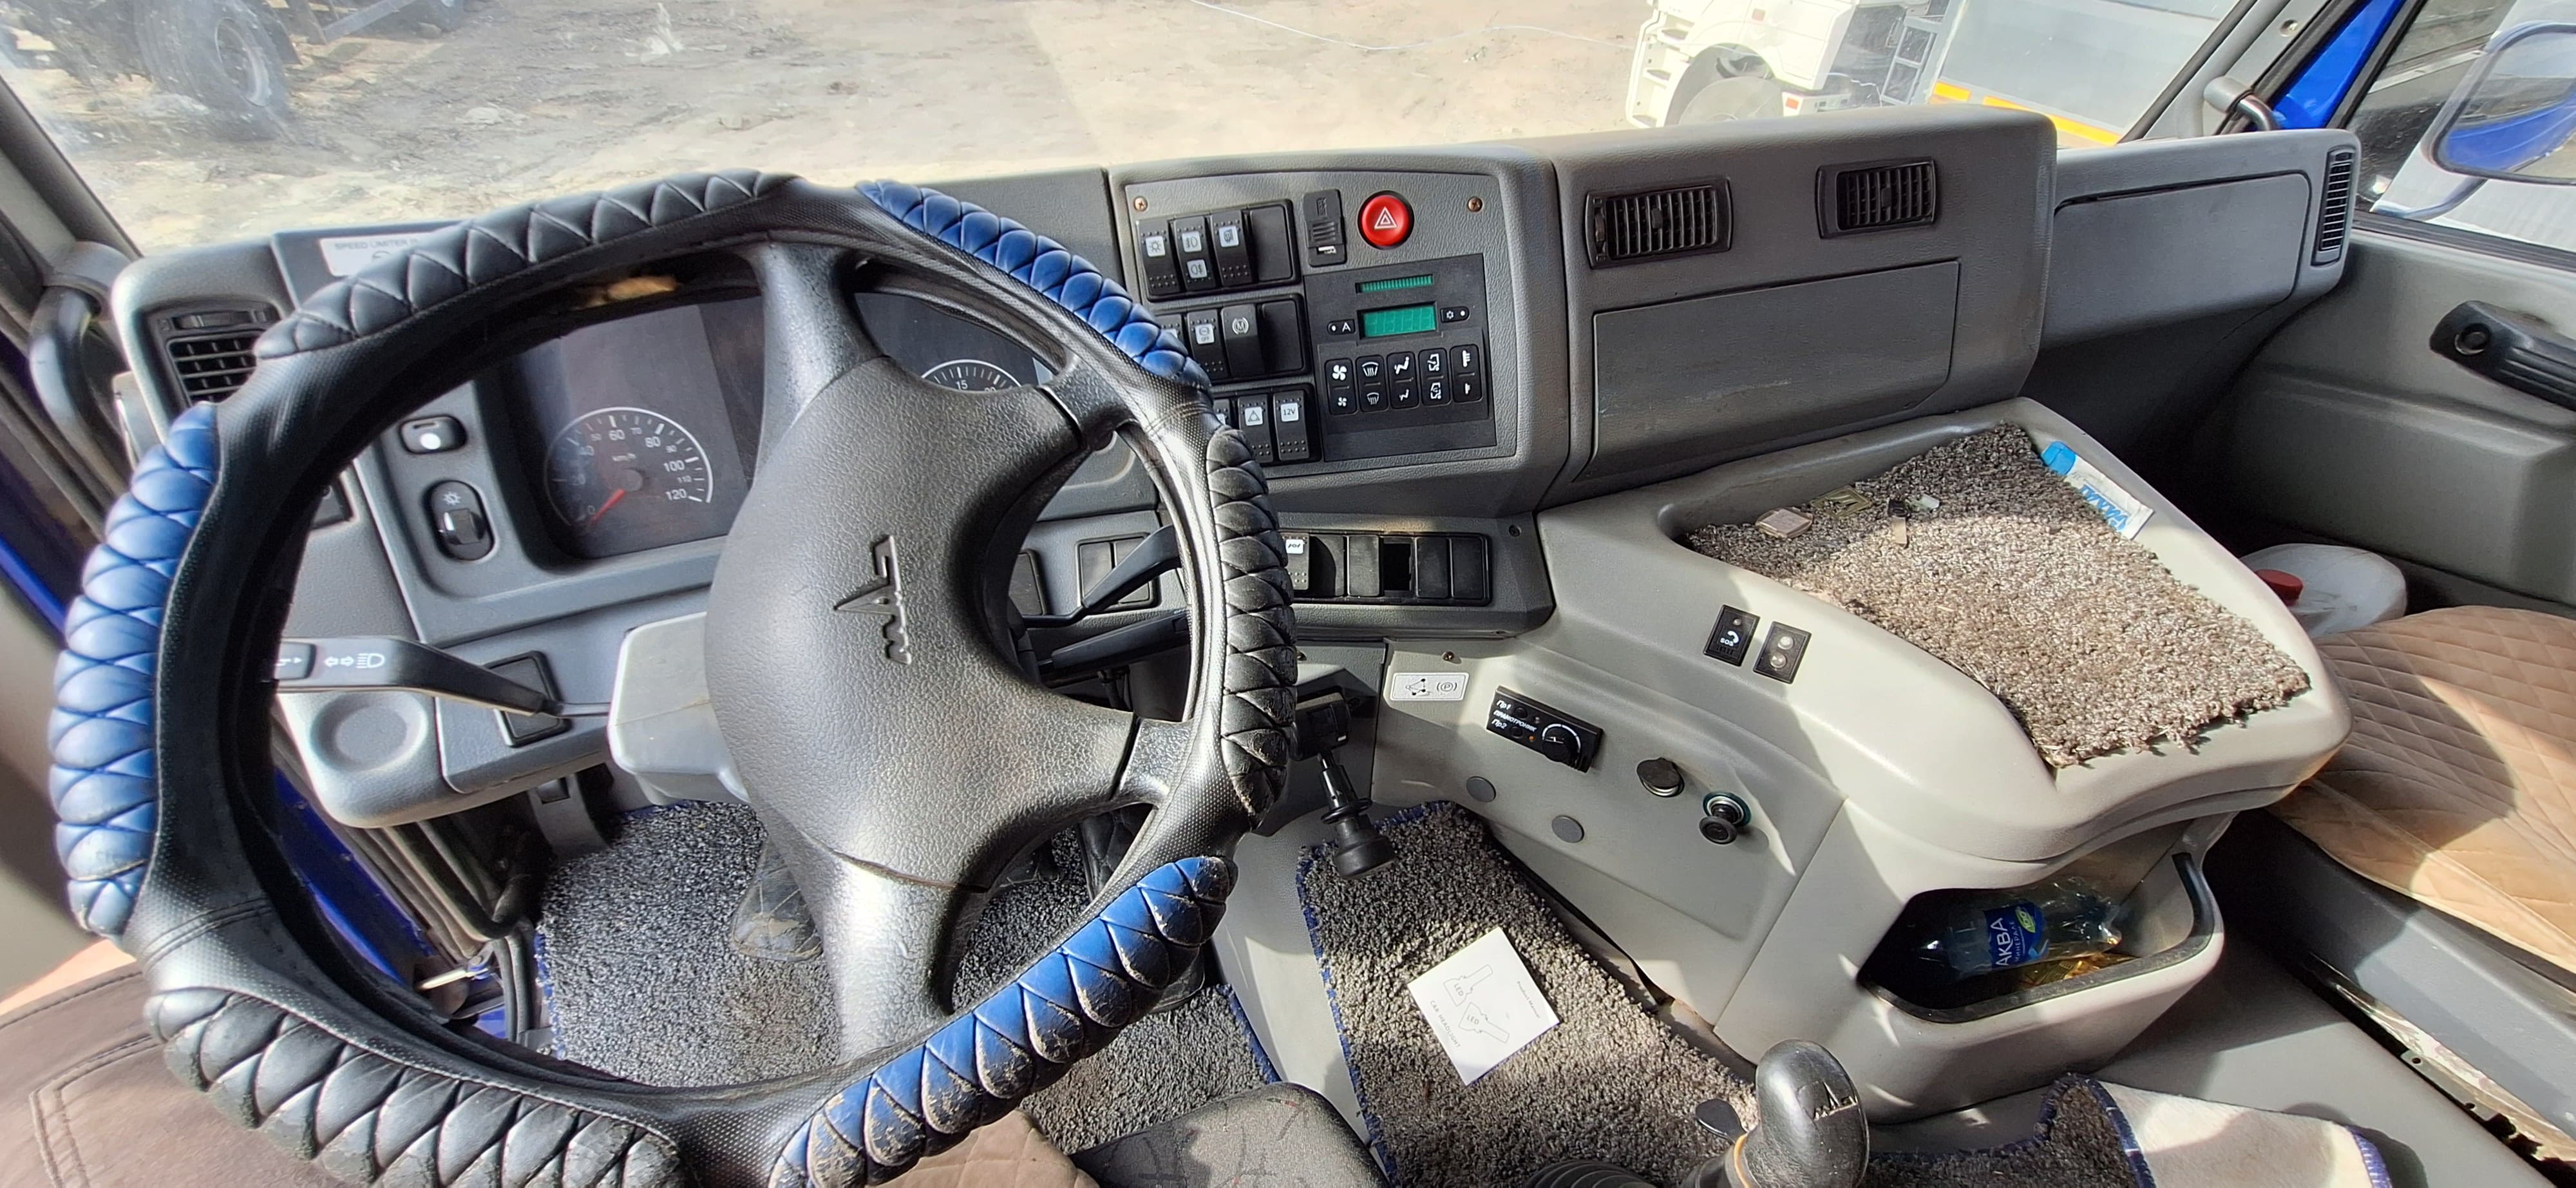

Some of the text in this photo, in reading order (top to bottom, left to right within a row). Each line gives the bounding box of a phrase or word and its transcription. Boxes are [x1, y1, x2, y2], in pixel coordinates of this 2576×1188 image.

[334, 242, 368, 250] SPEED
[370, 238, 408, 248] LIMITER
[1342, 322, 1351, 332] A
[956, 379, 968, 390] 15
[591, 433, 601, 441] 50
[609, 429, 625, 441] 60
[645, 436, 661, 448] 80
[663, 460, 685, 472] 100
[665, 488, 687, 501] 120
[1719, 637, 1734, 647] SOS
[1990, 917, 2014, 966] АКВА
[1454, 983, 1464, 997] LED
[1430, 1000, 1461, 1048] CAR HEADLIGHT
[1467, 1015, 1480, 1026] LED
